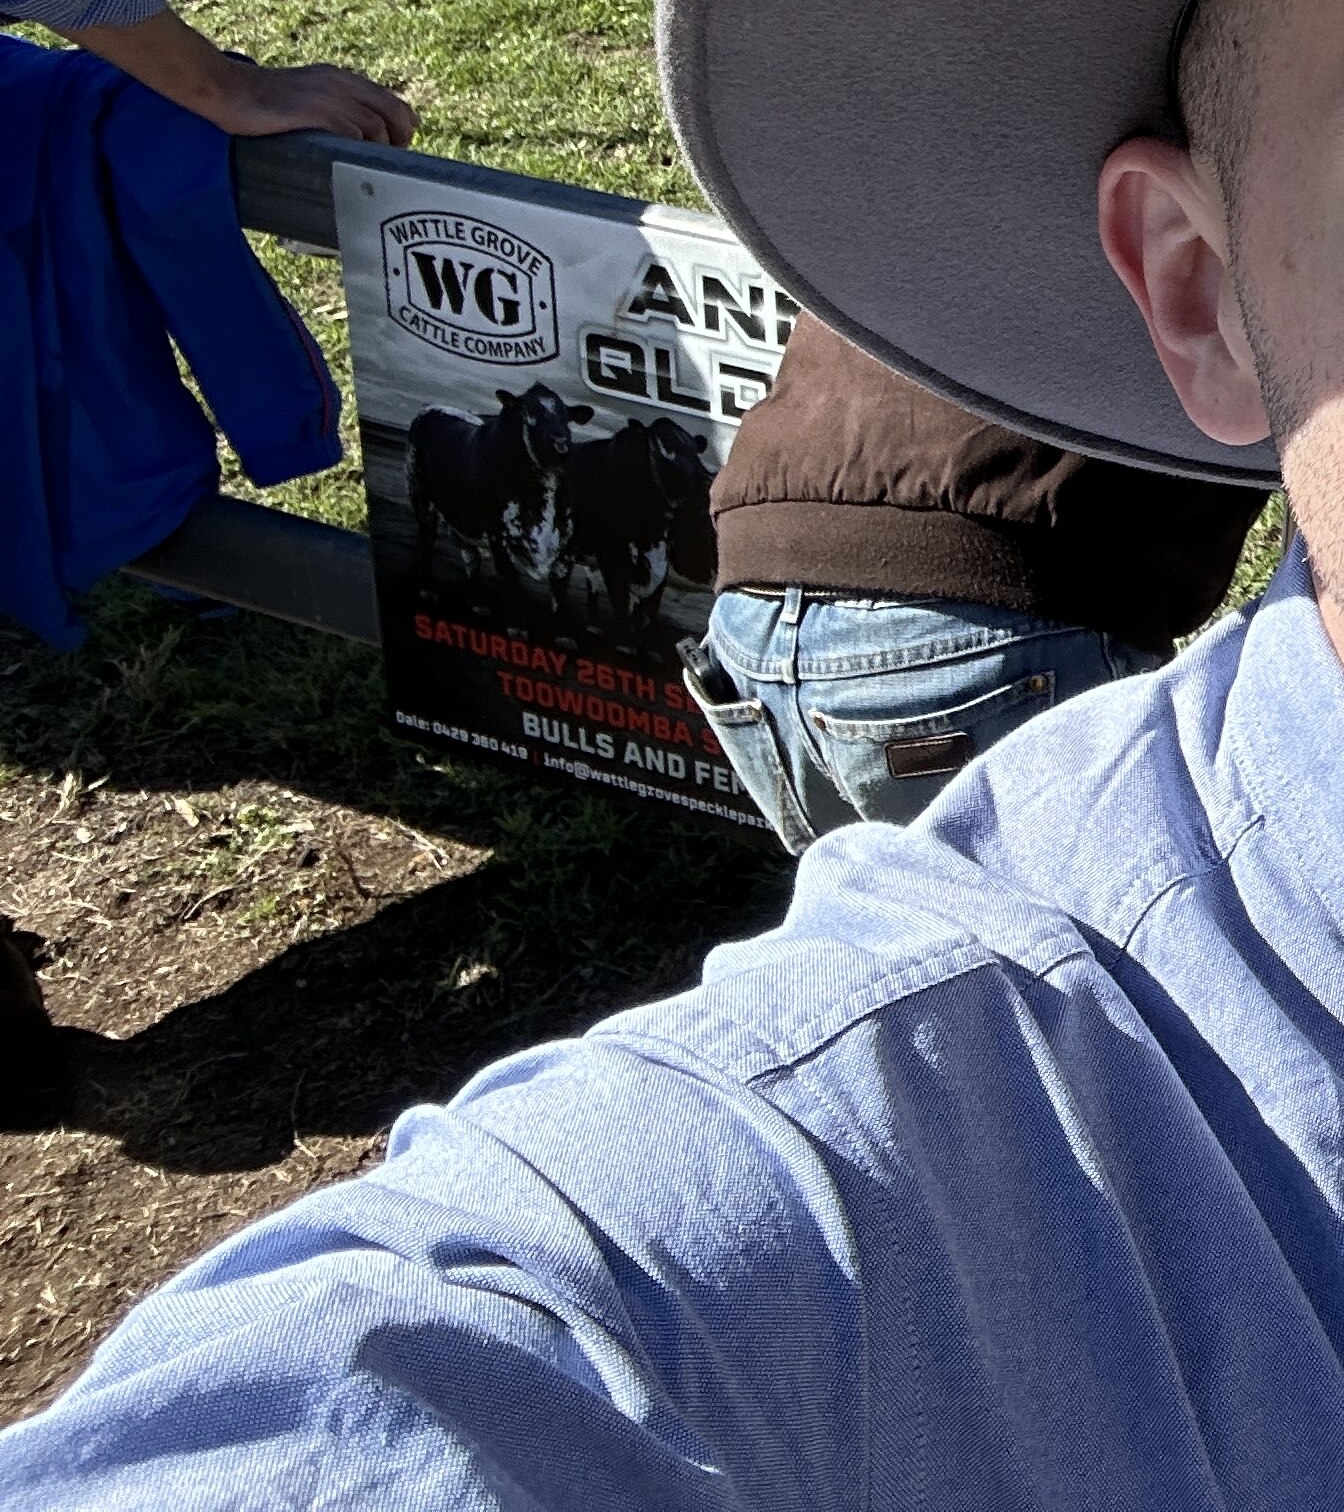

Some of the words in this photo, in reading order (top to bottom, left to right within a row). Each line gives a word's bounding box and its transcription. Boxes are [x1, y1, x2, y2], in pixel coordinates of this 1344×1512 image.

[389, 219, 467, 245] WATTLE
[471, 226, 543, 277] GROVE
[410, 251, 521, 327] WG
[399, 306, 461, 349] CATTLE
[464, 335, 546, 359] COMPANY
[414, 613, 567, 677] SATURDAY
[576, 658, 656, 702] 26TH
[395, 709, 431, 731] Dale:
[432, 722, 469, 743] 0429
[496, 669, 694, 748] TOOWOOMBA
[522, 711, 615, 760] BULLS
[623, 740, 686, 781] AND
